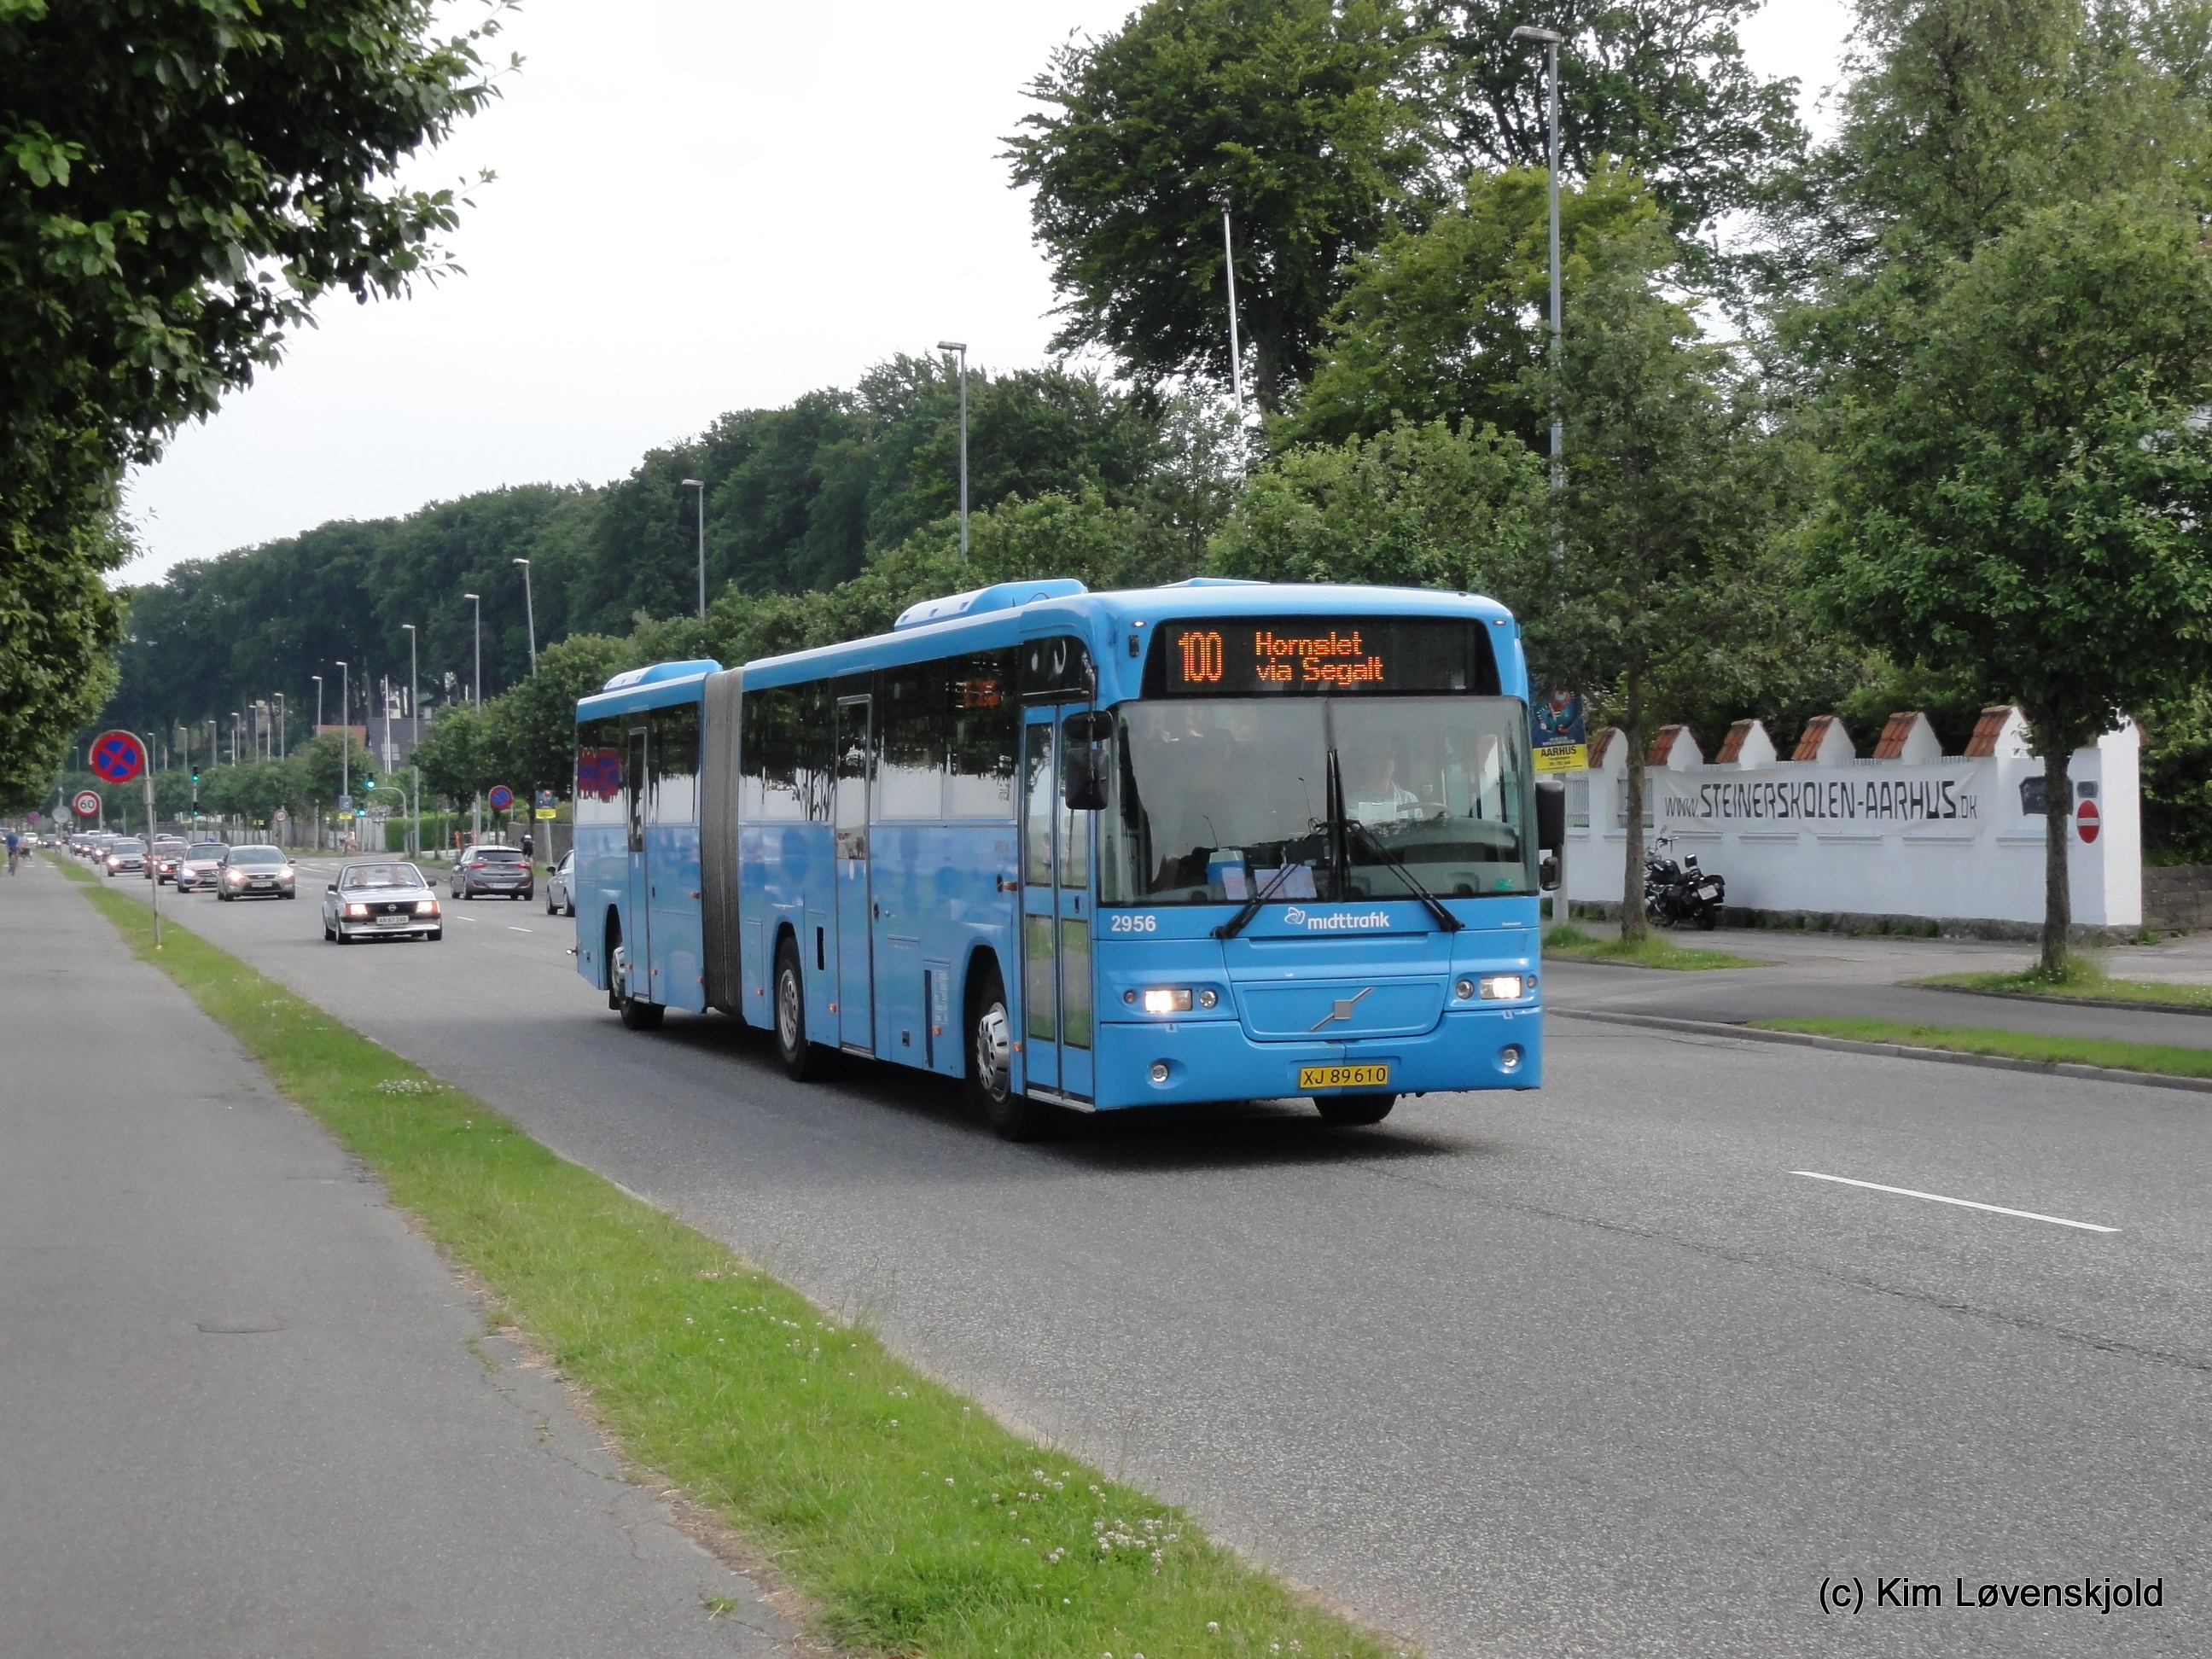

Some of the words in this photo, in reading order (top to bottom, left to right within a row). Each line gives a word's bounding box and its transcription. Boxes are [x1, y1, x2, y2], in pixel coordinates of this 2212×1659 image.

[1178, 632, 1222, 682] 100
[1255, 632, 1362, 655] Hornslet
[1255, 657, 1292, 680] via
[1302, 656, 1383, 685] Segalt
[1540, 745, 1577, 757] AARHUS
[79, 800, 96, 809] 60
[1111, 915, 1156, 932] 2956
[1303, 1069, 1324, 1086] XJ
